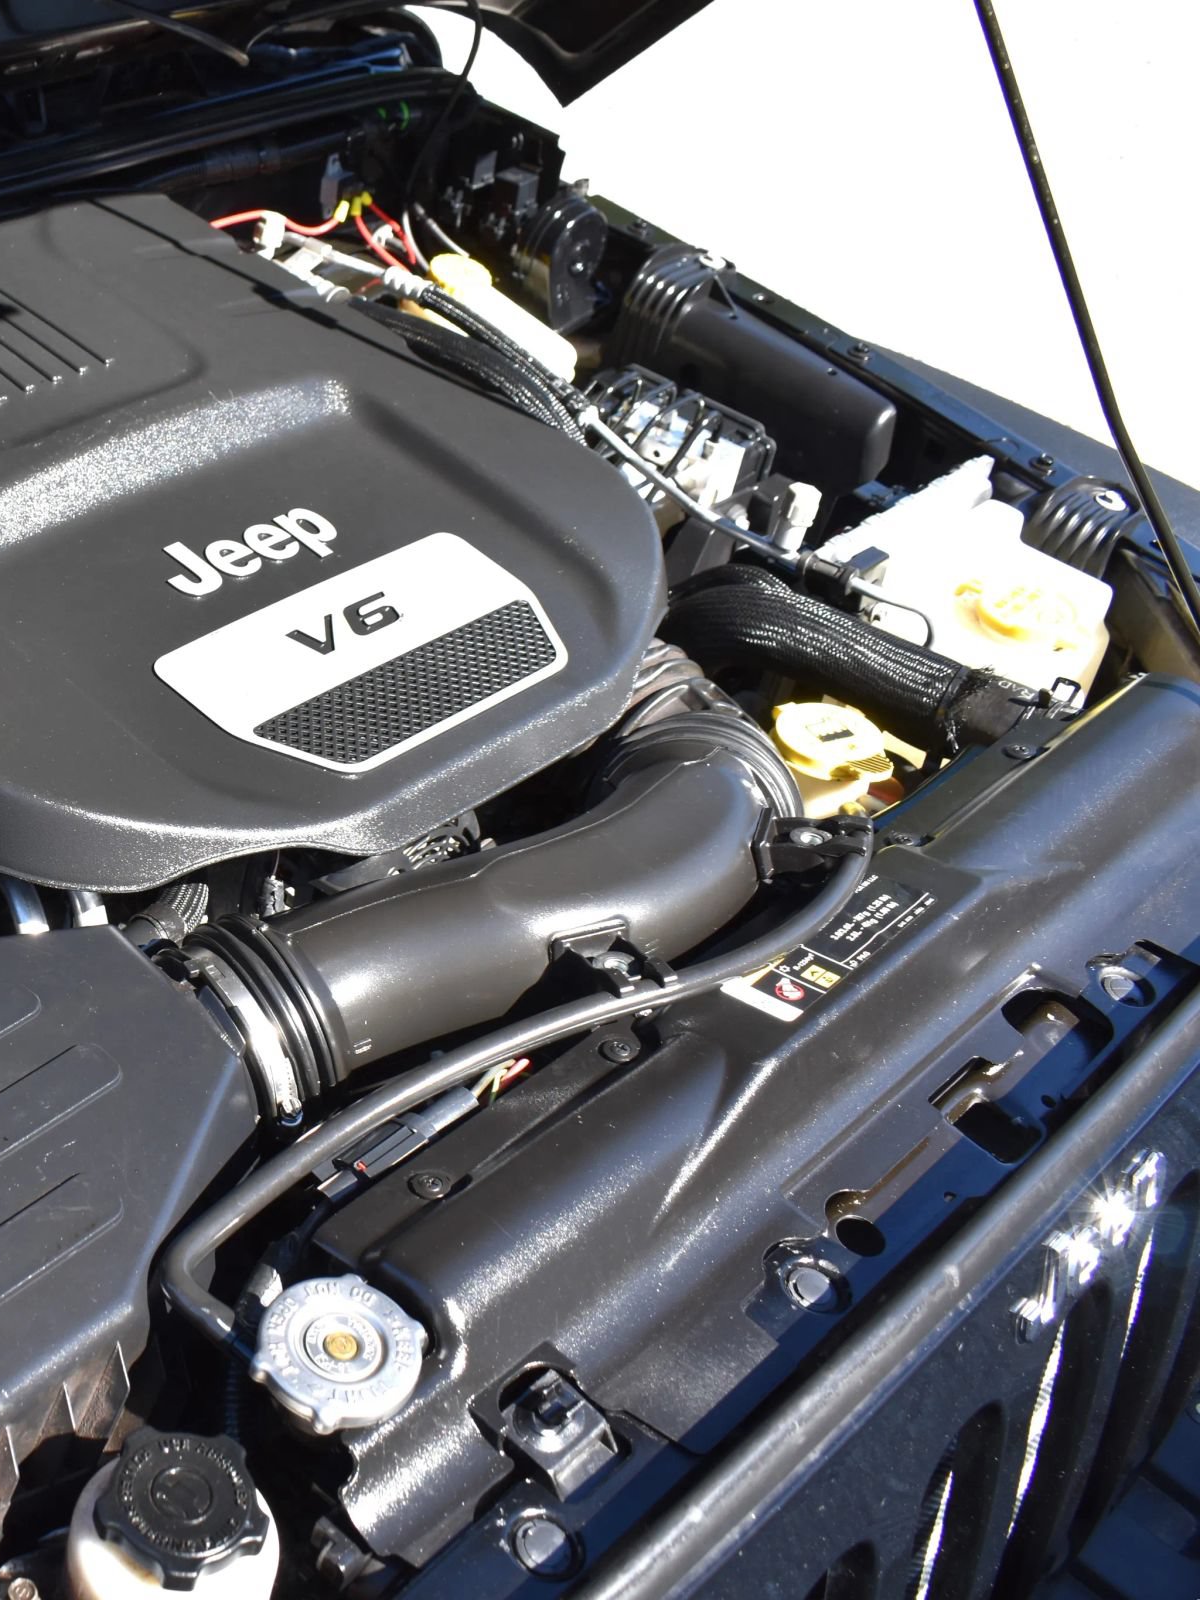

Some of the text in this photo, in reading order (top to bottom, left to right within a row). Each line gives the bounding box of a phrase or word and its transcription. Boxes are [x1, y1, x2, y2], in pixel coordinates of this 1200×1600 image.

[162, 507, 338, 598] Jeep
[285, 591, 402, 655] V6
[998, 681, 1035, 700] RAD
[348, 1287, 377, 1307] DO
